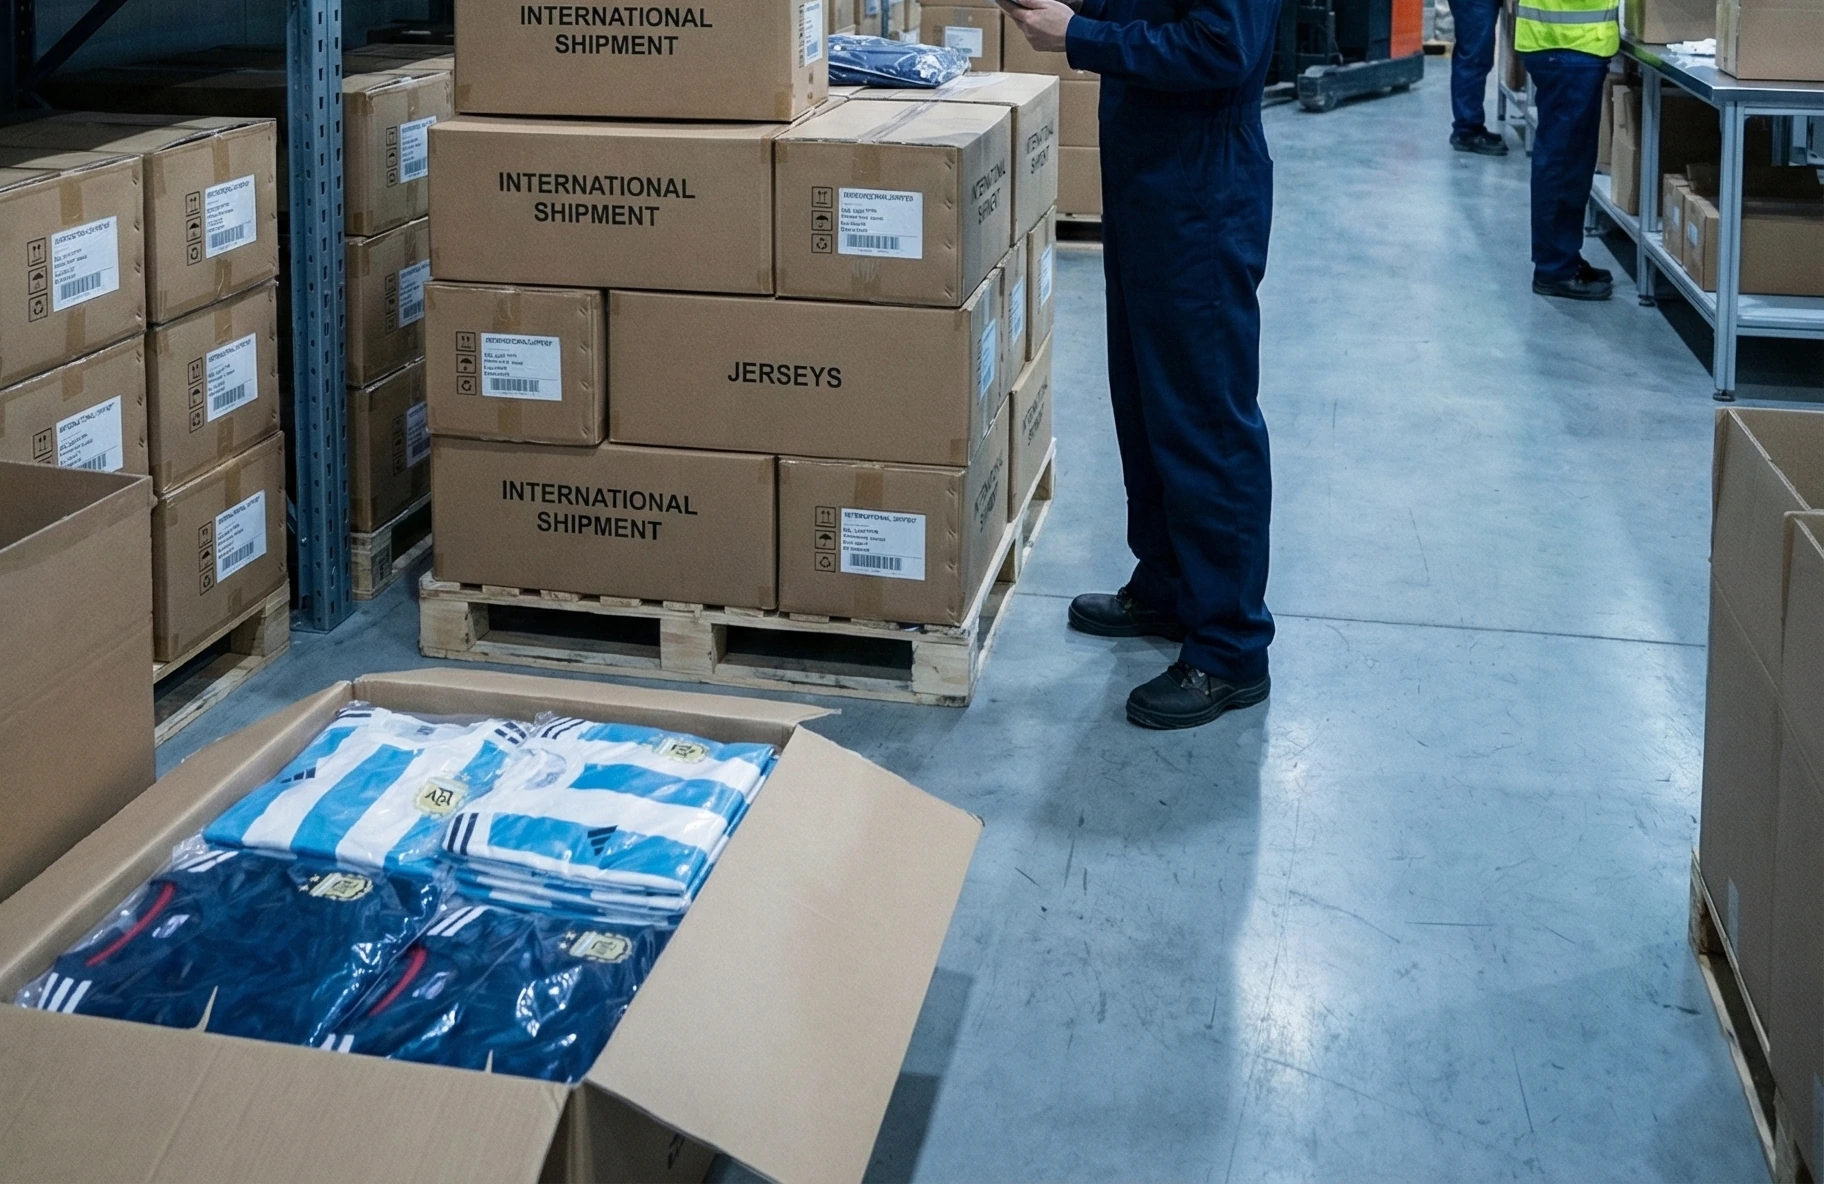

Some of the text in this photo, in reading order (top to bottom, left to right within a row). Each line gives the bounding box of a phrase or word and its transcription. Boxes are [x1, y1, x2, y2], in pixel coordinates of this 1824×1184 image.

[520, 5, 713, 28] INTERNATIONAL
[555, 33, 679, 55] SHIPMENT
[499, 172, 696, 199] INTERNATIONAL
[534, 201, 660, 227] SHIPMENT
[727, 361, 842, 388] JERSEYS
[502, 480, 698, 515] INTERNATIONAL
[537, 511, 662, 541] SHIPMENT
